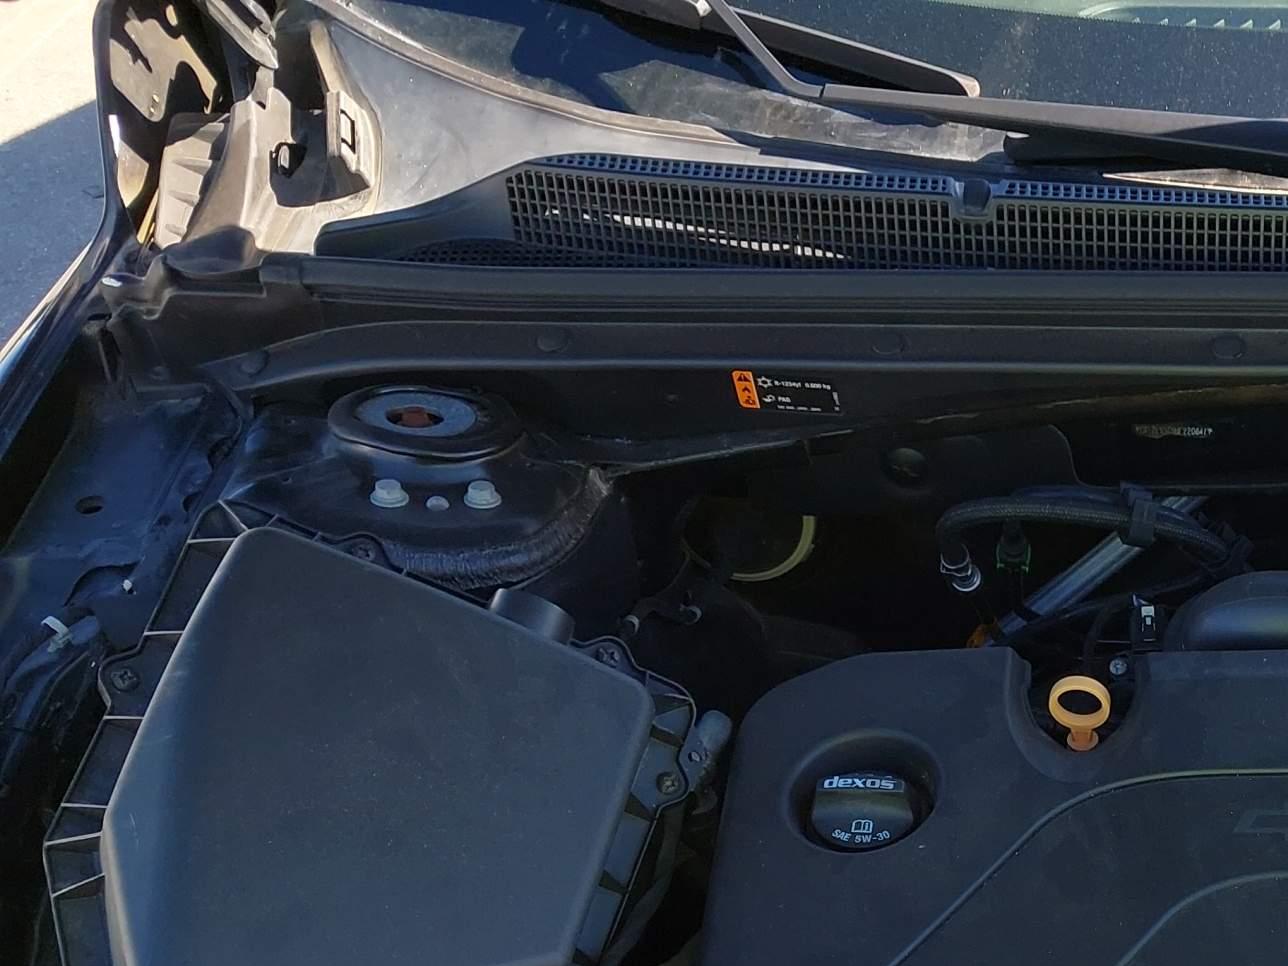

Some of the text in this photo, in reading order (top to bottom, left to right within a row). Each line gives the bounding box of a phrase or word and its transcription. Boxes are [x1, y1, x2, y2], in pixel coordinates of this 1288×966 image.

[823, 775, 896, 790] dexos
[831, 828, 891, 844] SAE 5W-30
